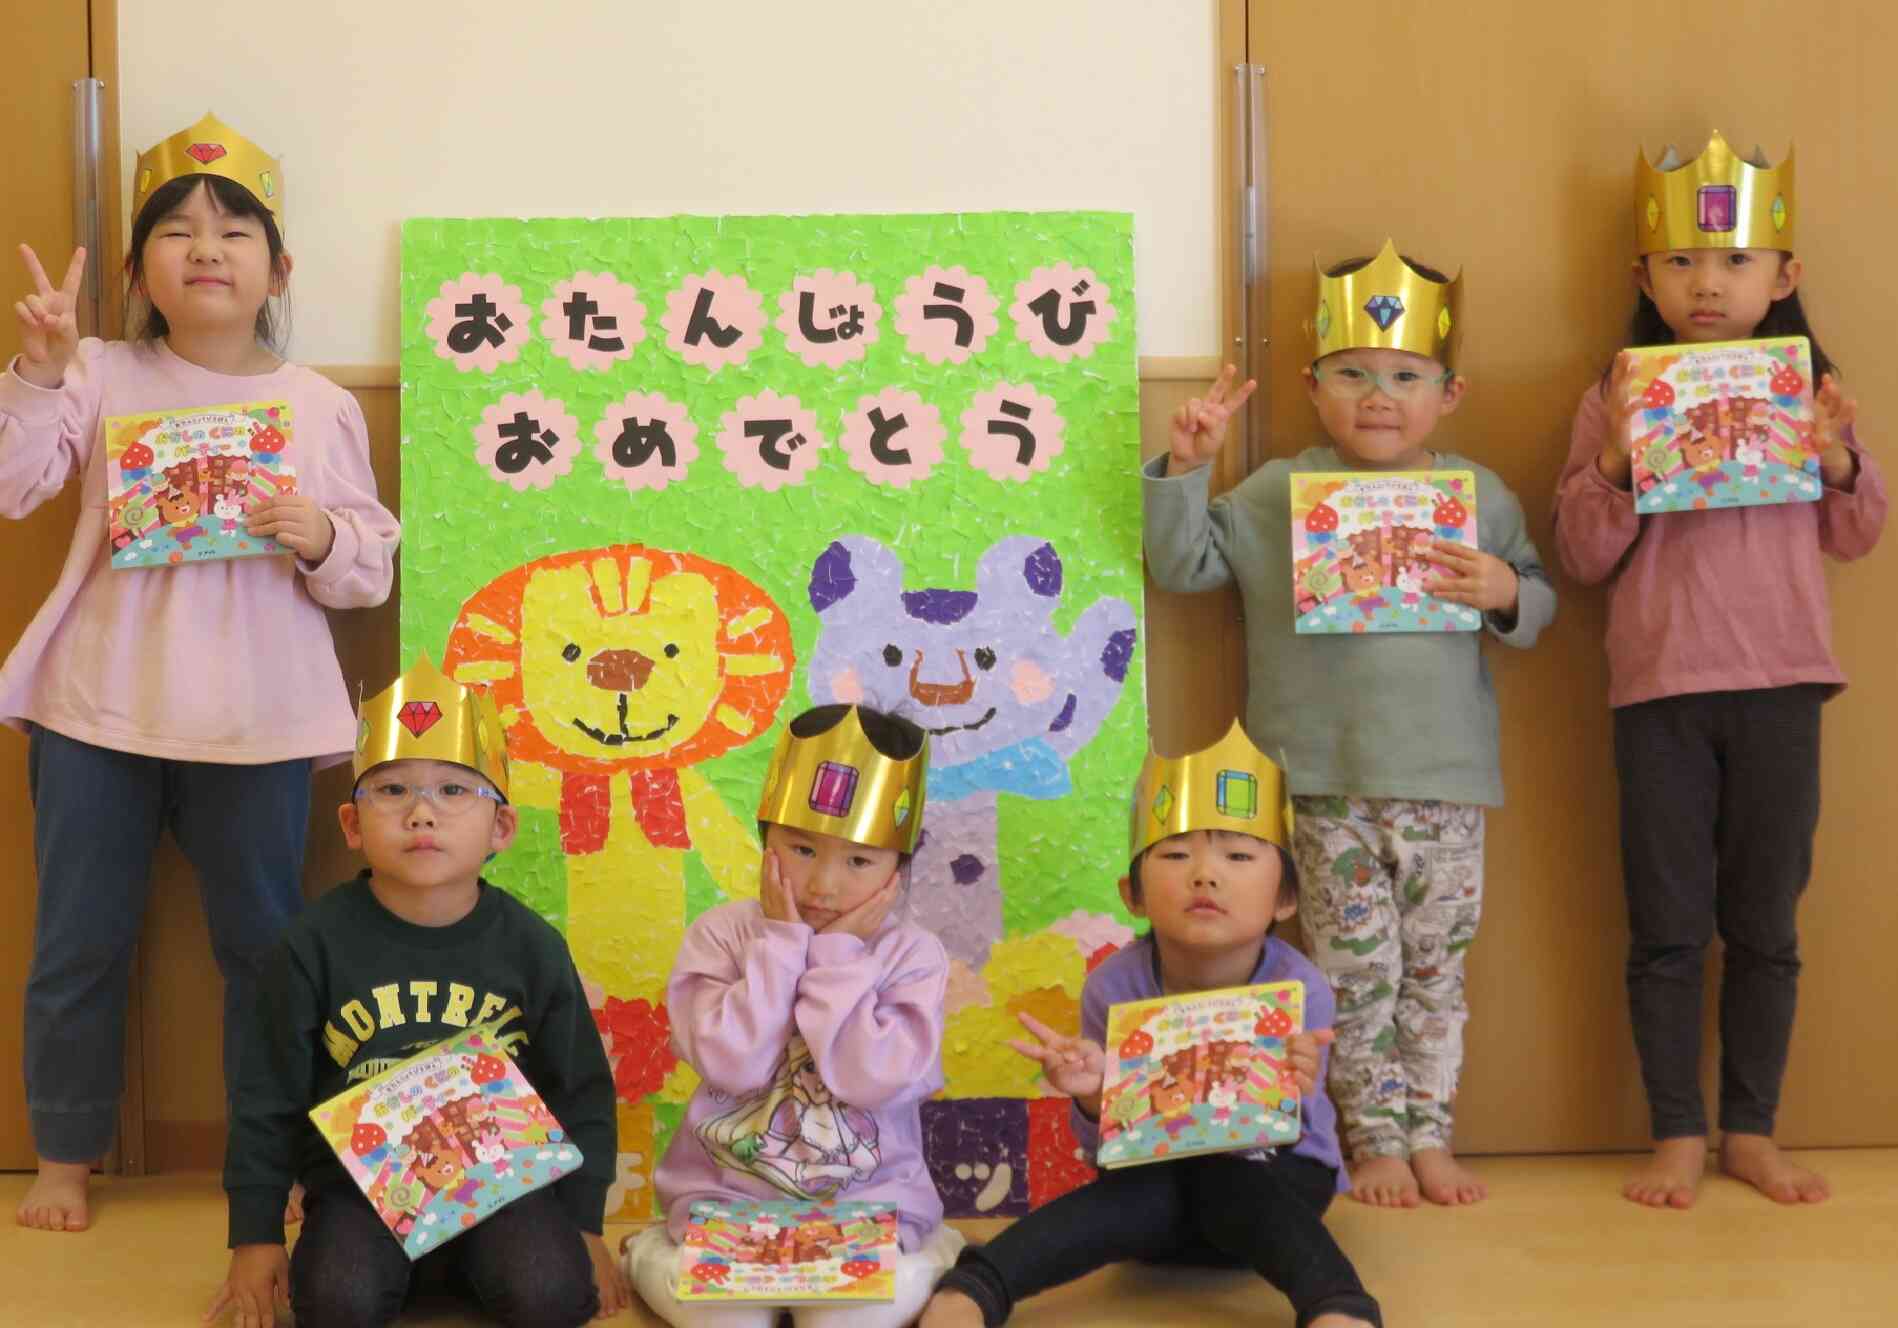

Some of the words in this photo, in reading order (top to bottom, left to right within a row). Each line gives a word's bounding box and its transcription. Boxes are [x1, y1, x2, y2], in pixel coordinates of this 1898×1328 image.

[446, 279, 1098, 354] おたんじょうび
[495, 399, 1037, 474] おめでとう
[322, 981, 529, 1068] MONTRE
